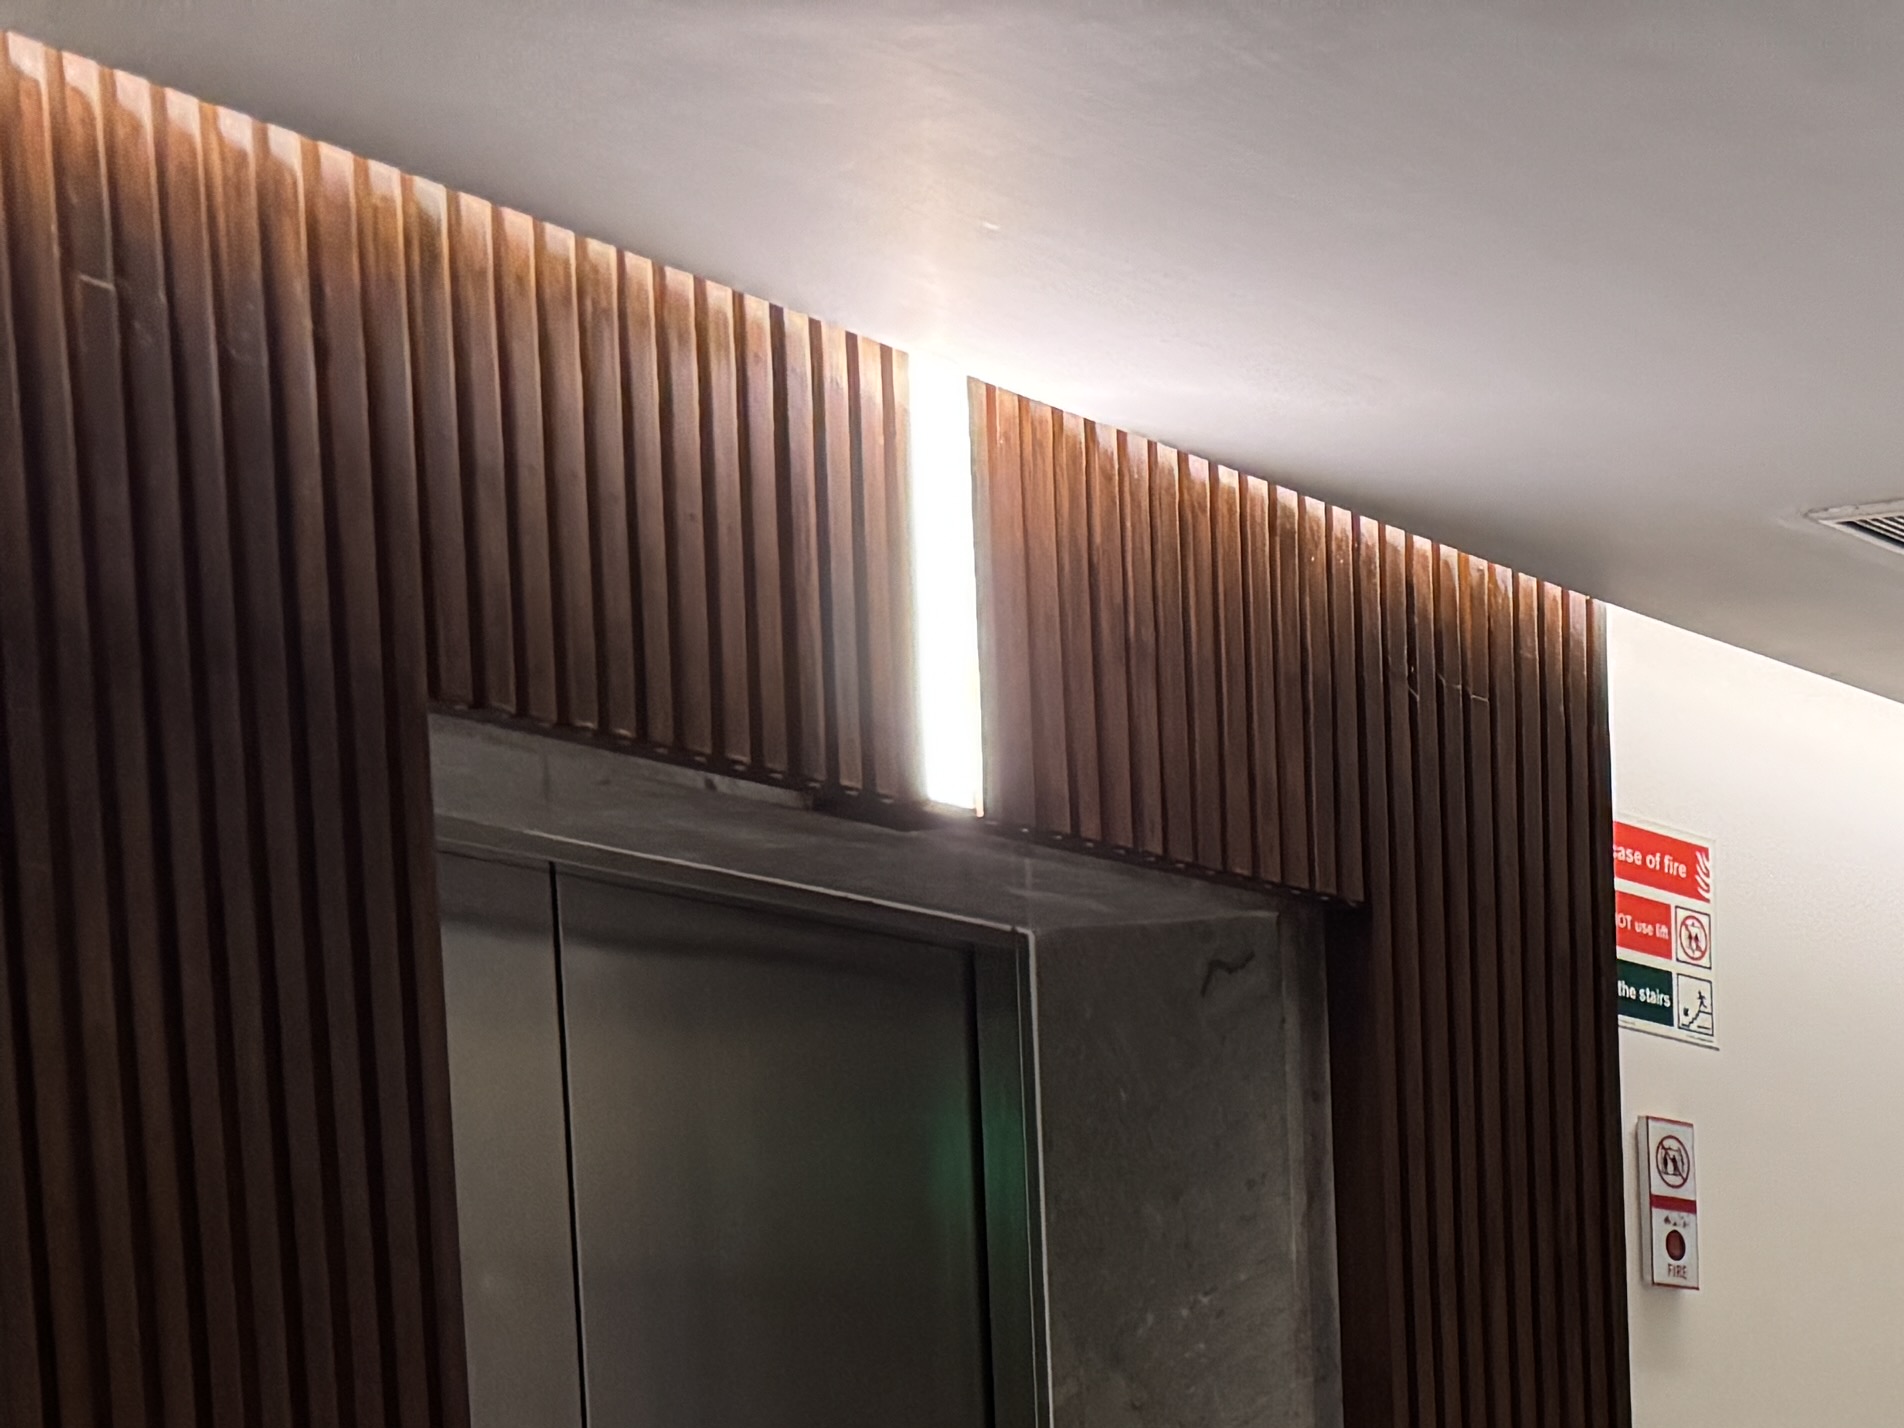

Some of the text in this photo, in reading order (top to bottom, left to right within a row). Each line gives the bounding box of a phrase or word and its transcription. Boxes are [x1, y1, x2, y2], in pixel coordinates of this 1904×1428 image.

[1646, 852, 1661, 870] of
[1663, 854, 1687, 878] fire
[1634, 921, 1654, 937] use
[1617, 980, 1671, 1008] the stairs
[1667, 1263, 1687, 1280] FIRE
